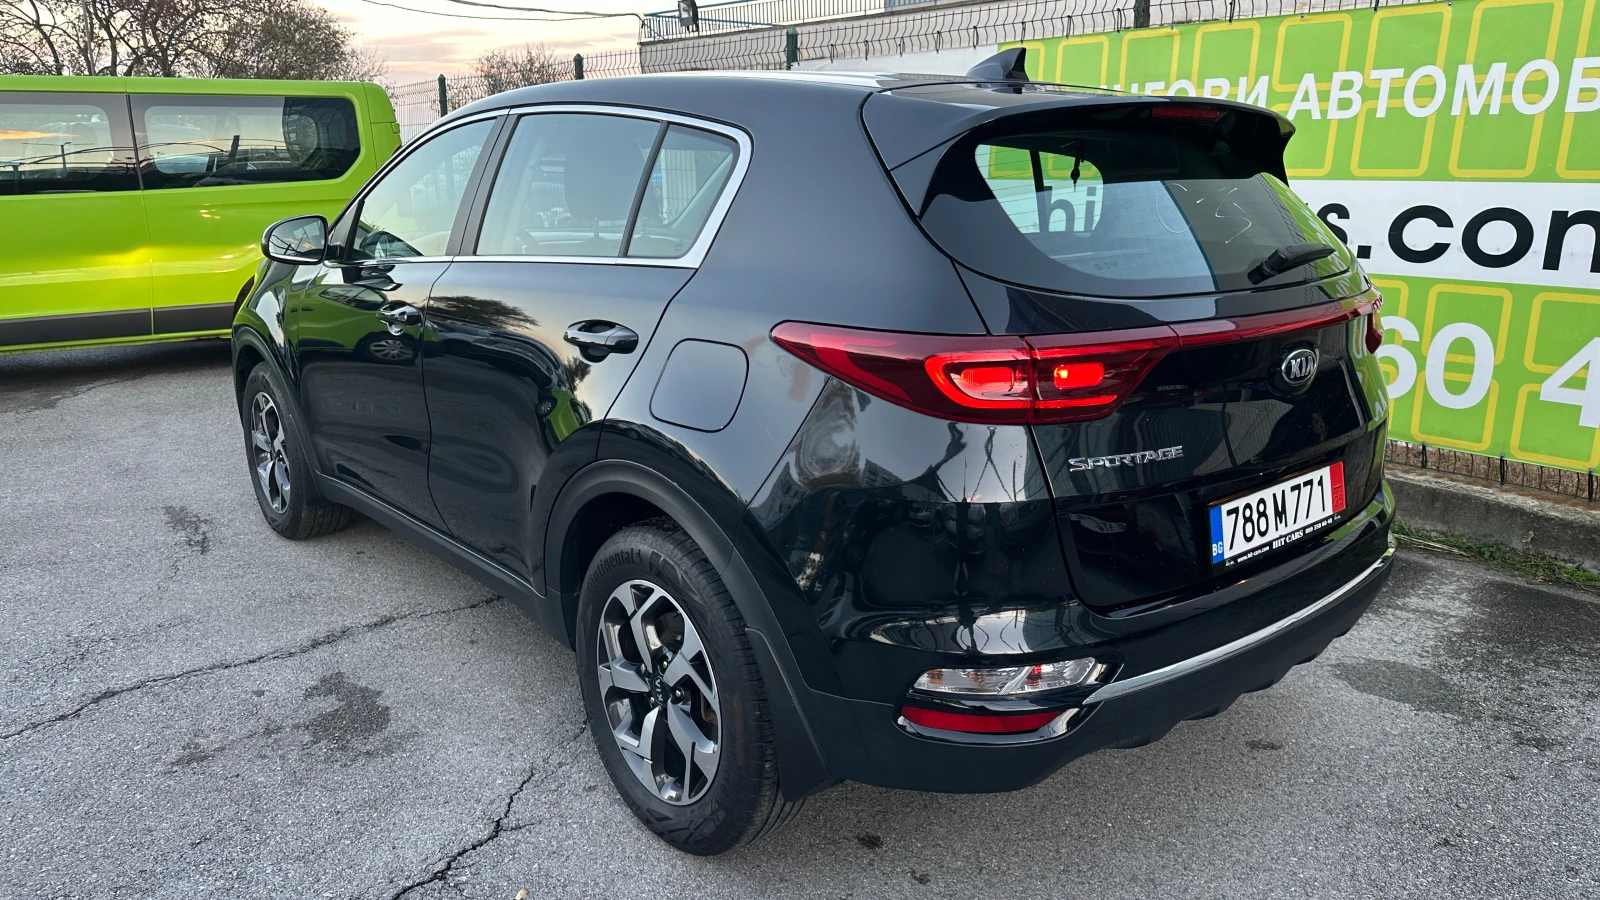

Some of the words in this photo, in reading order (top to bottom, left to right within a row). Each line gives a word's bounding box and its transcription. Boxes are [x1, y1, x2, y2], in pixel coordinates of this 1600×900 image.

[1287, 56, 1600, 120] АВТОМОБ
[1290, 355, 1314, 378] KIA
[1377, 315, 1494, 409] 60
[1068, 446, 1183, 472] SPORTAGE
[1212, 541, 1223, 557] BG
[1272, 537, 1286, 550] HIT
[1286, 529, 1304, 543] CARS
[587, 547, 636, 592] Continental
